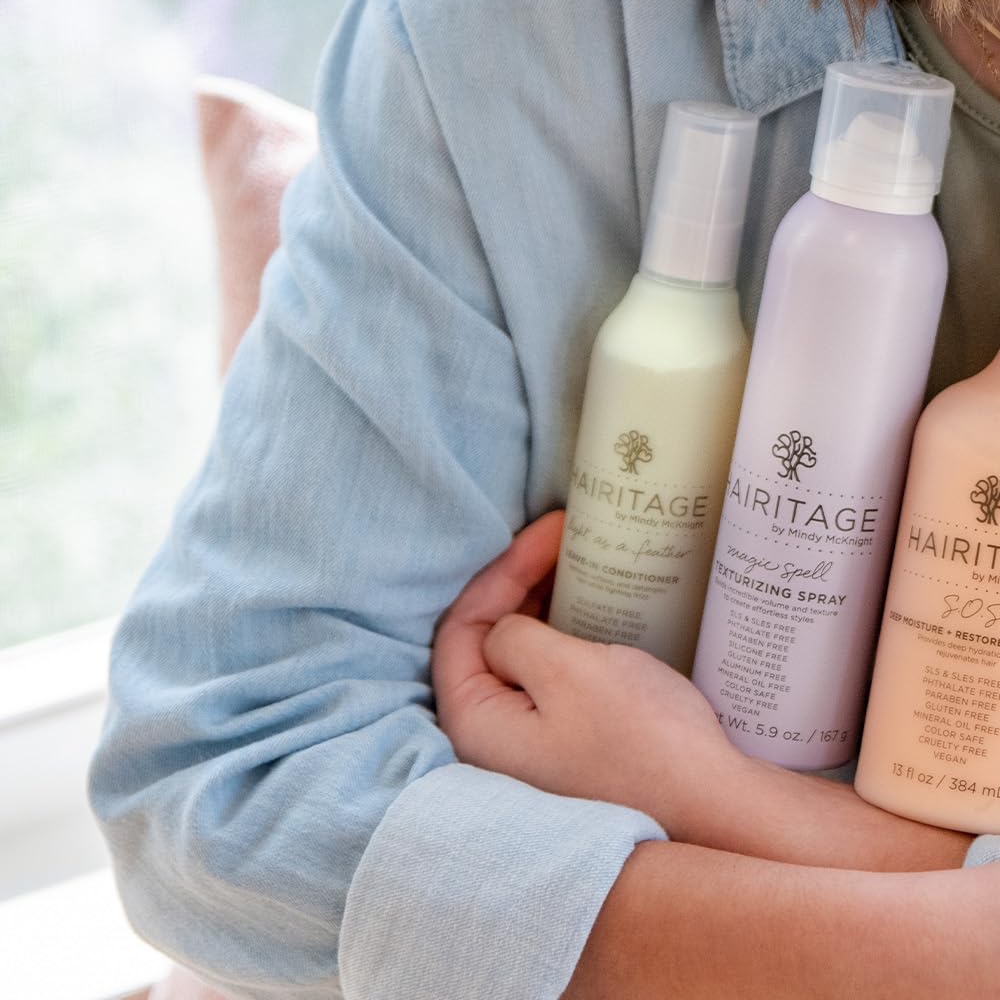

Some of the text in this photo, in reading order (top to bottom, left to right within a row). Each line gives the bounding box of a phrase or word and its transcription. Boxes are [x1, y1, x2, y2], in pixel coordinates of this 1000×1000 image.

[615, 512, 704, 530] by Mindy McKnight
[772, 525, 872, 548] by Mindy McKnight
[632, 539, 692, 564] feather
[727, 545, 780, 574] magic
[602, 565, 679, 585] CONDITIONER
[716, 560, 792, 599] TEXTURIZING
[798, 591, 847, 606] SPRAY
[972, 572, 985, 583] by
[731, 598, 750, 609] create
[752, 605, 788, 620] effortless
[790, 615, 814, 624] styles
[761, 598, 790, 610] volume
[792, 605, 808, 614] and
[810, 608, 838, 616] texture
[728, 619, 796, 644] PHTHALATE FREE
[751, 617, 771, 629] SLES
[774, 622, 796, 634] FREE
[903, 615, 944, 635] MOISTURE
[728, 640, 788, 662] SILICONE FREE
[729, 630, 789, 652] PARABEN FREE
[917, 634, 946, 648] Provides
[947, 641, 967, 652] deep
[728, 650, 782, 672] GLUTEN FREE
[936, 649, 997, 667] rejuvenates hair
[718, 667, 791, 693] MINERAL OIL FREE
[721, 659, 787, 682] ALUMINUM FREE
[925, 665, 940, 676] SLS
[942, 670, 948, 678] &
[951, 672, 974, 683] SLES
[724, 680, 776, 700] COLOR SAFE
[922, 676, 976, 696] PHTHALATE
[720, 688, 779, 710] CRUELTY FREE
[732, 703, 760, 716] VEGAN
[925, 689, 998, 712] PARABEN FREE
[925, 701, 990, 722] GLUTEN FREE
[728, 715, 750, 733] Wt.
[755, 723, 778, 738] 5.9
[783, 731, 803, 742] oz.
[807, 729, 817, 744] /
[820, 730, 839, 742] 167
[841, 732, 848, 742] g
[913, 710, 1000, 736] MINERAL OIL FREE
[924, 724, 985, 745] COLOR SAFE
[918, 735, 988, 757] CRUELTY FREE
[933, 751, 967, 765] VEGAN
[892, 762, 903, 776] 13
[906, 767, 914, 780] fl
[917, 773, 934, 785] oz
[935, 774, 946, 789] /
[948, 777, 976, 794] 384
